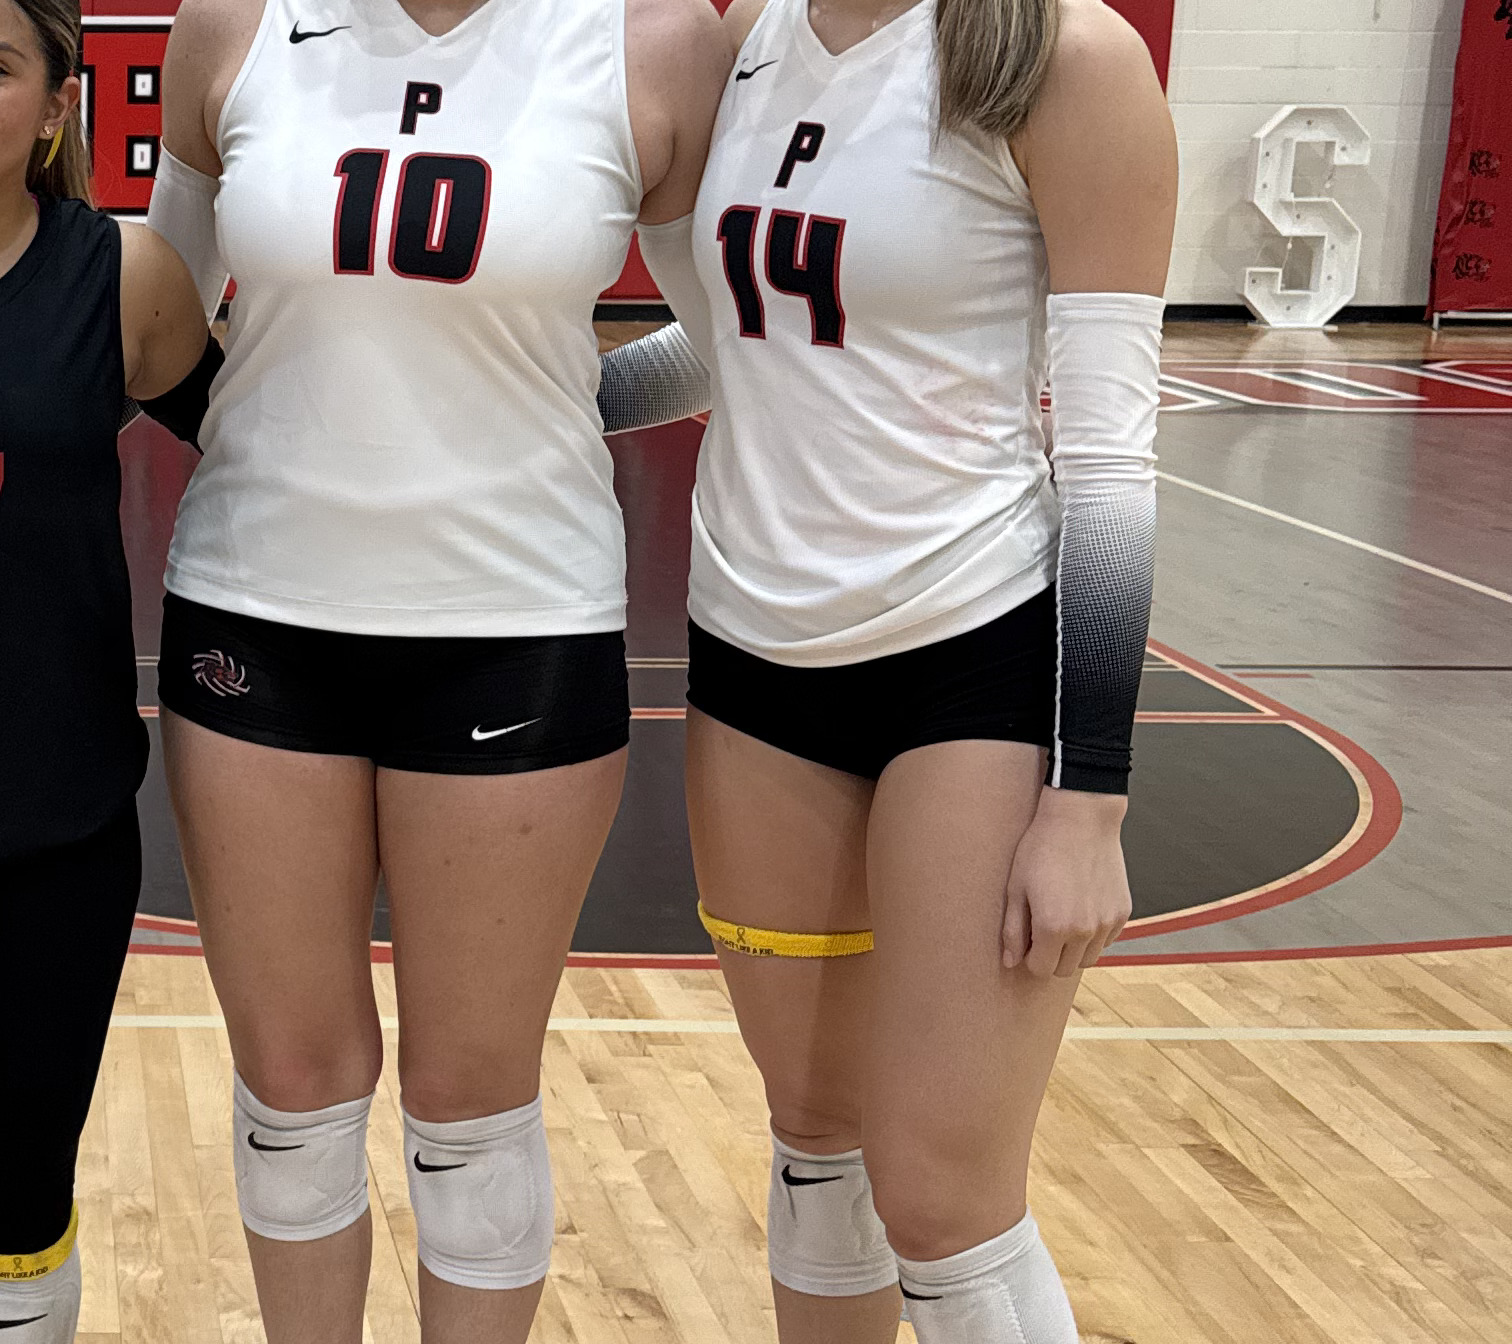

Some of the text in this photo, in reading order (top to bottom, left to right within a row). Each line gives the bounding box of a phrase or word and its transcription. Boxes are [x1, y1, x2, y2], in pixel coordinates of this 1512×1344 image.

[399, 80, 444, 135] P
[773, 120, 826, 188] P
[332, 147, 493, 285] 10
[1243, 105, 1370, 328] S
[716, 204, 847, 350] 14
[36, 1266, 48, 1275] KID
